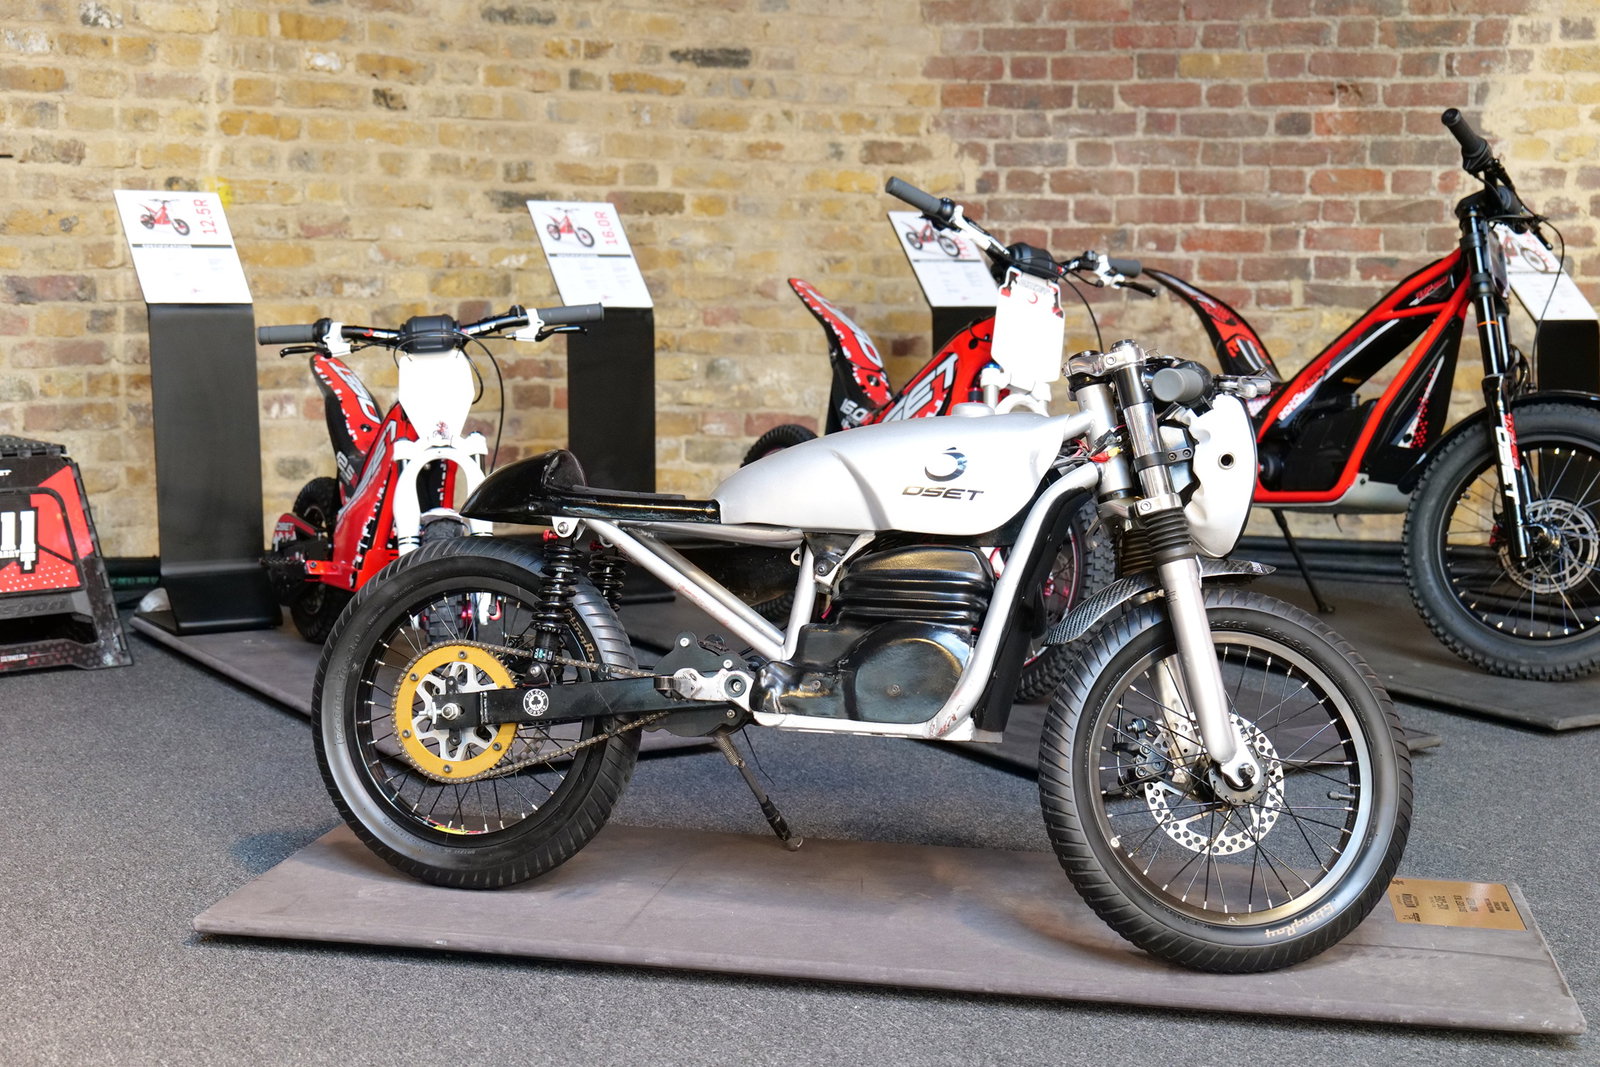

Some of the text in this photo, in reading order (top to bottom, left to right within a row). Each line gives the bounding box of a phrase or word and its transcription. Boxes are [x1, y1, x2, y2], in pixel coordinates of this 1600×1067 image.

[193, 199, 218, 235] 12.5R
[594, 211, 618, 245] 16.0R
[902, 485, 984, 501] OSET
